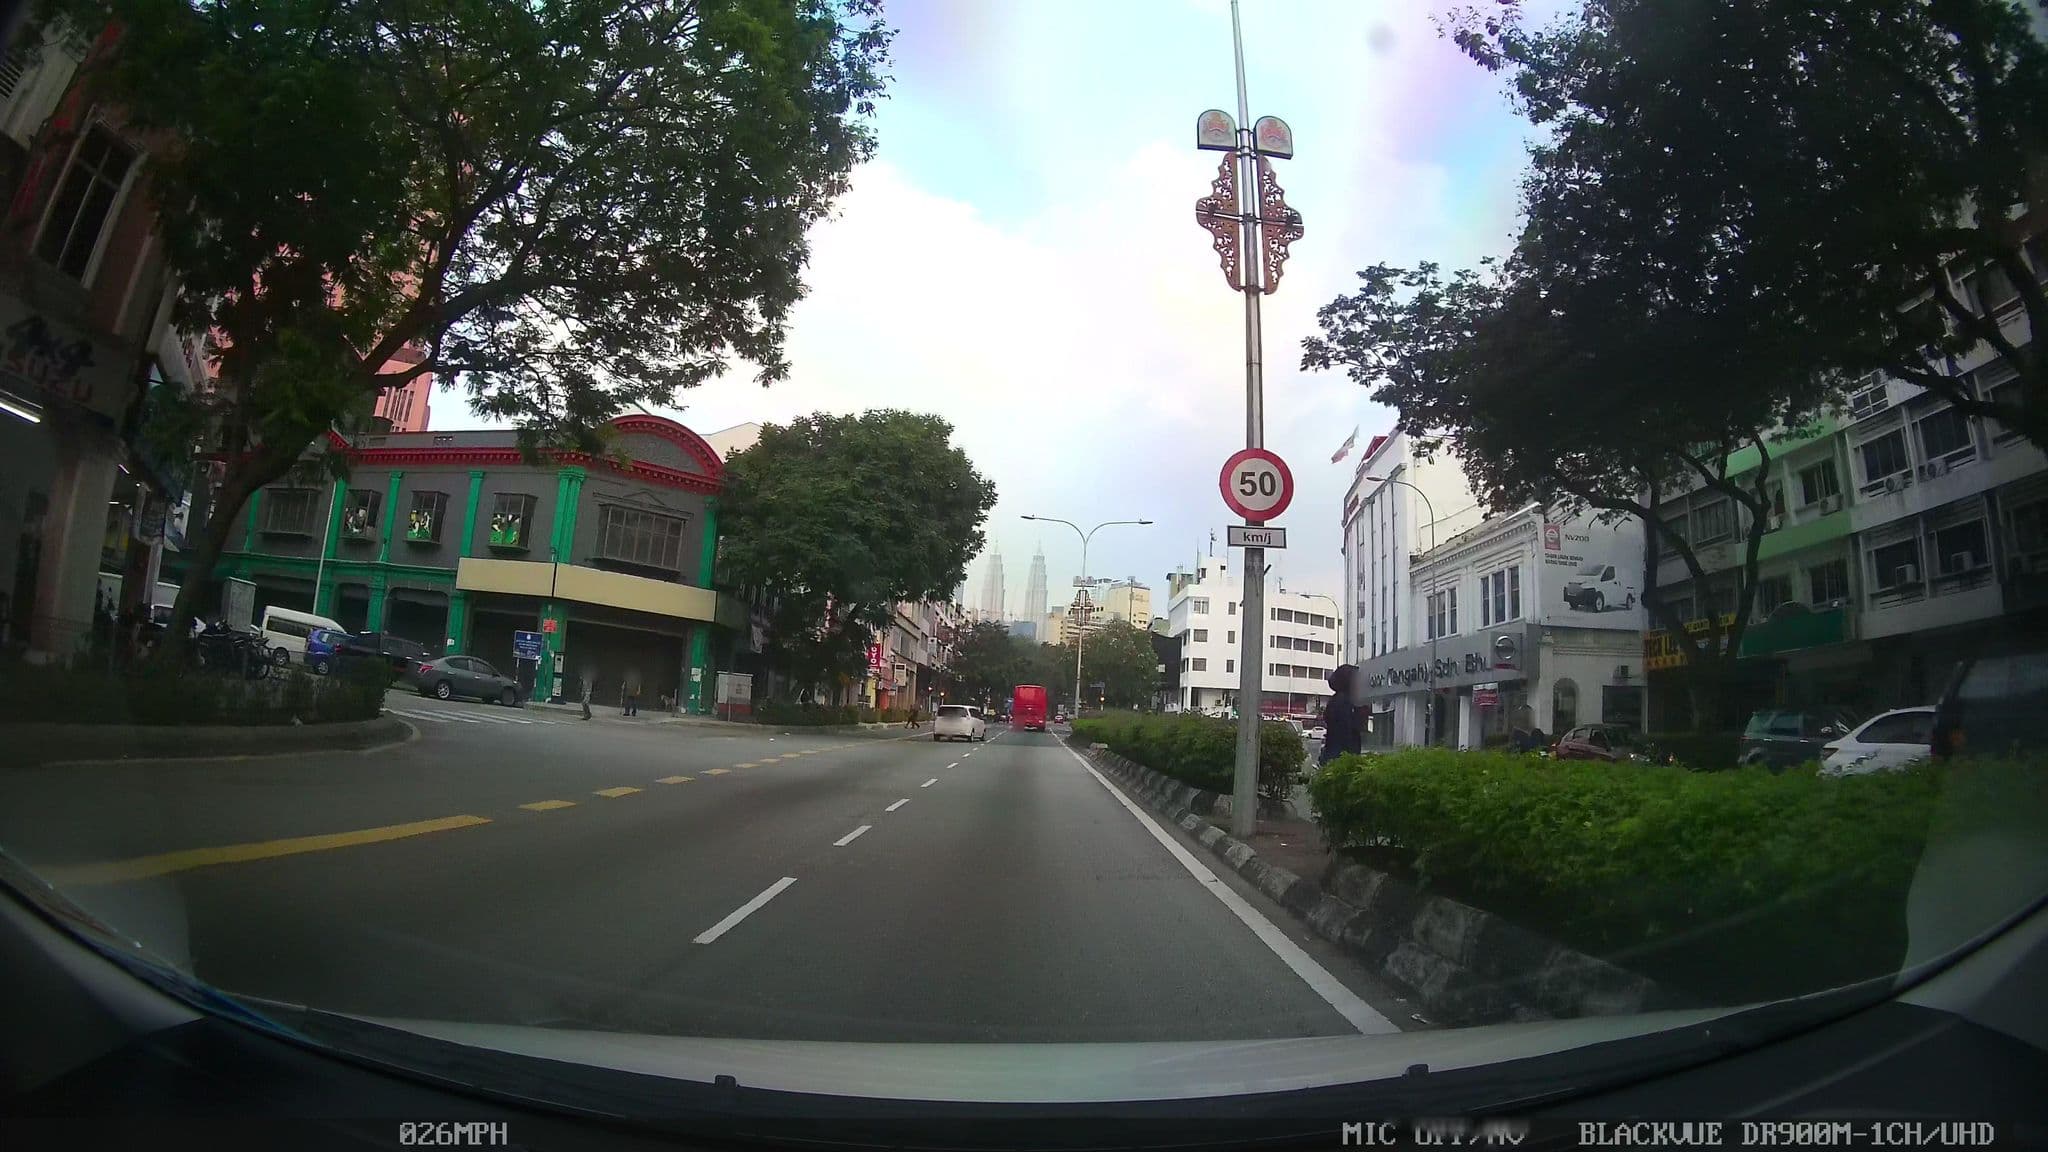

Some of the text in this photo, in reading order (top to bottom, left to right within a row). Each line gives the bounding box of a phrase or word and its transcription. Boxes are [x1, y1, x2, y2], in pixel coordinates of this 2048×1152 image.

[1240, 471, 1276, 496] 50
[1243, 531, 1271, 544] km/j
[870, 646, 878, 664] OYO
